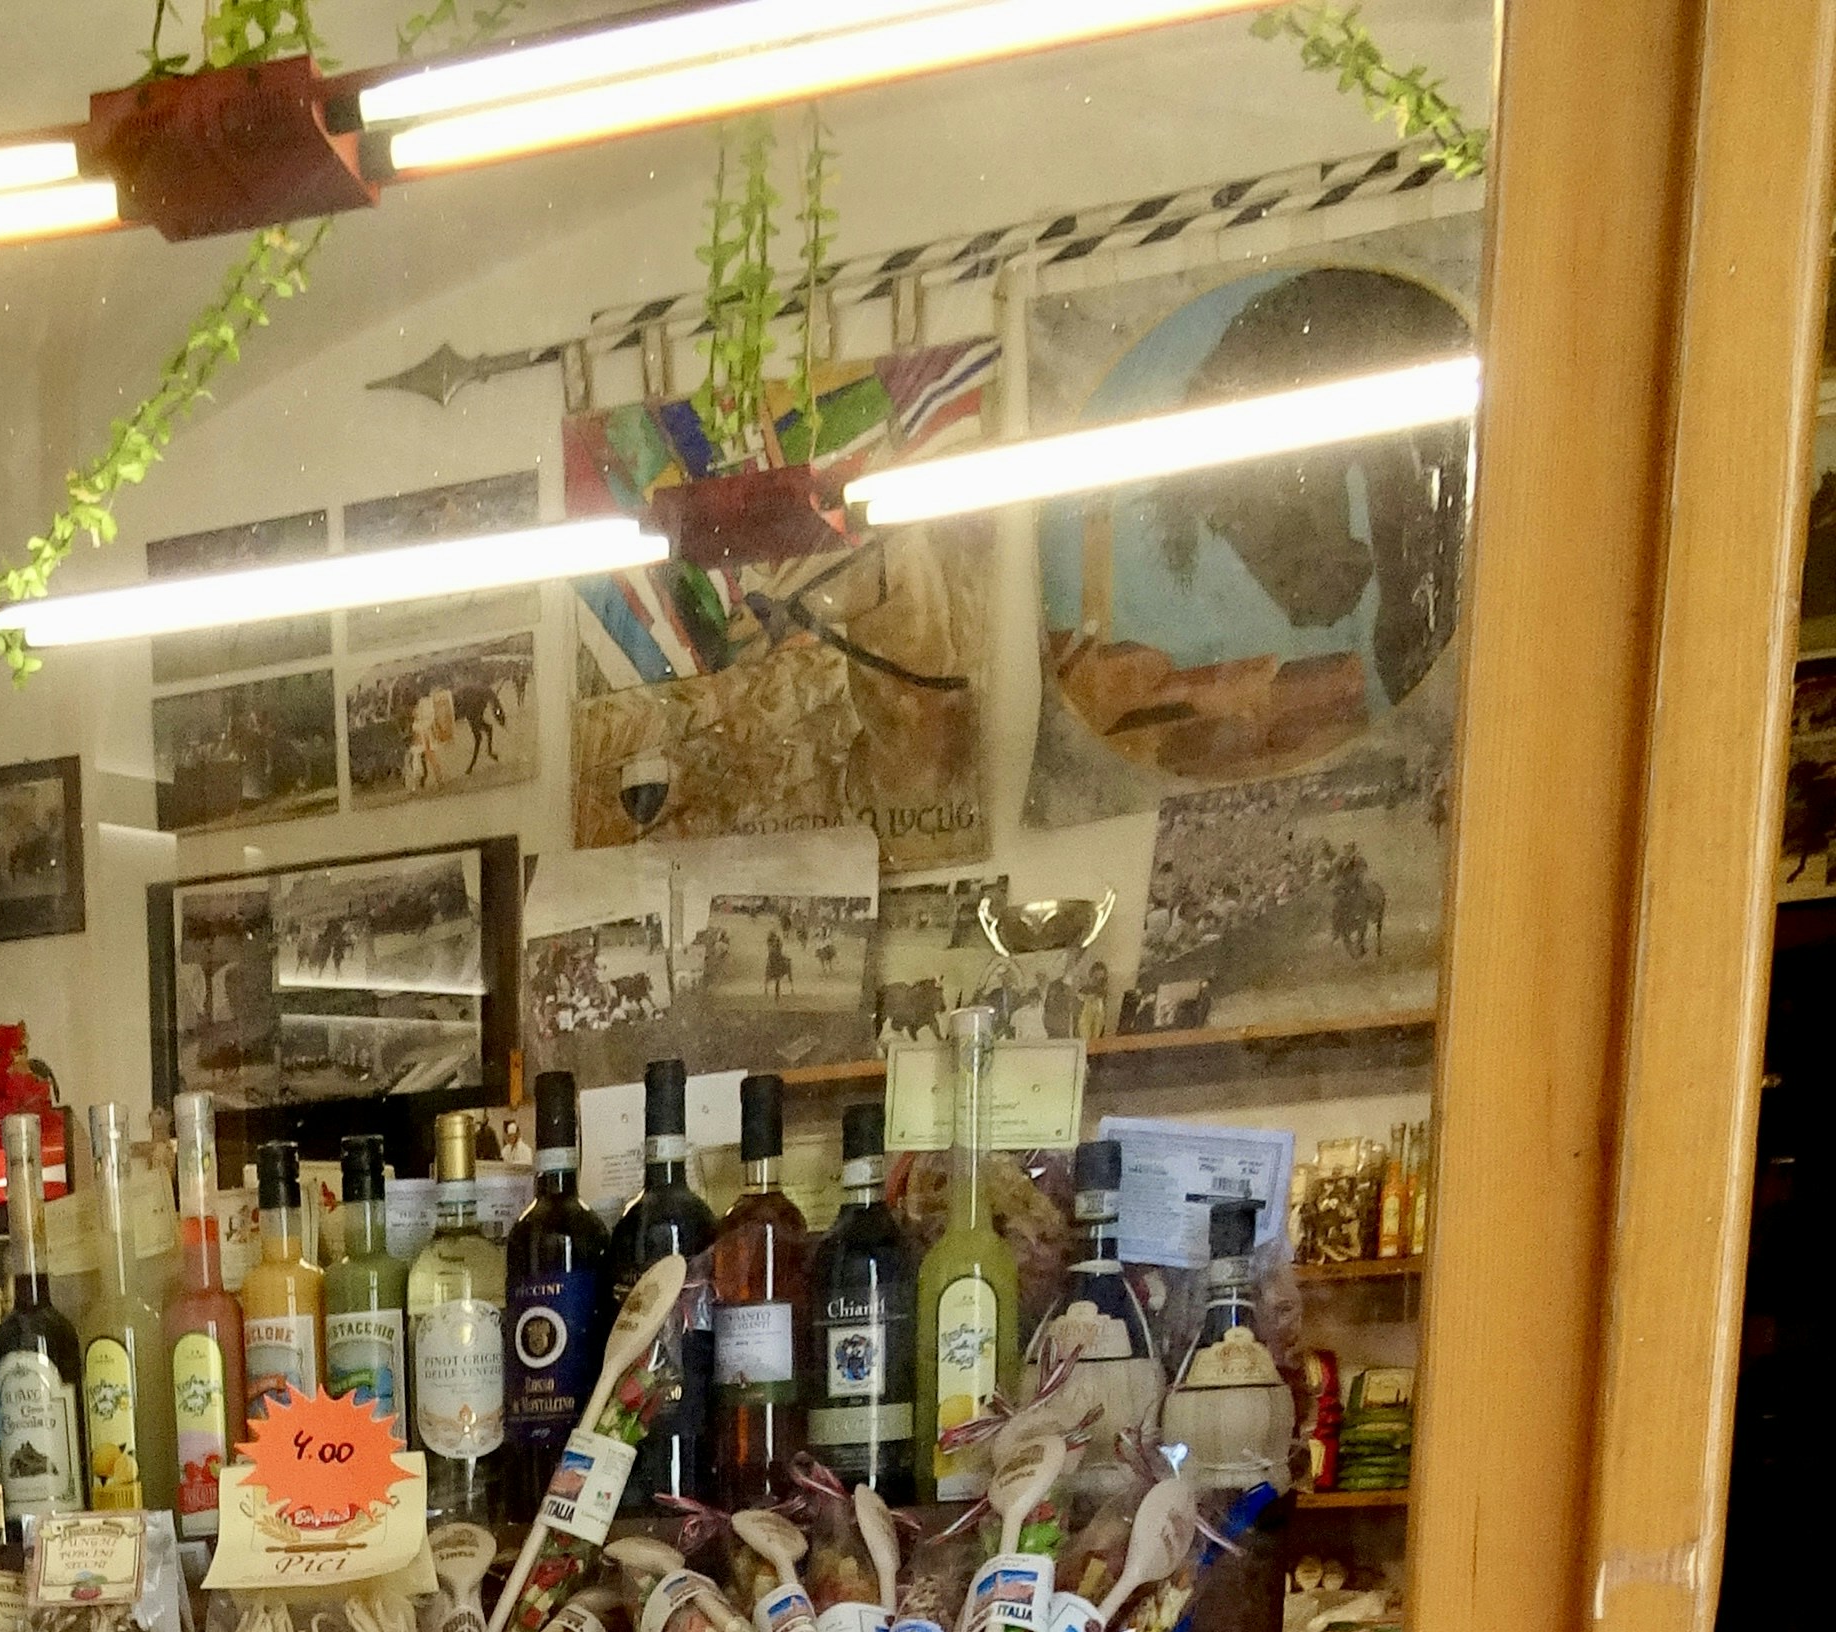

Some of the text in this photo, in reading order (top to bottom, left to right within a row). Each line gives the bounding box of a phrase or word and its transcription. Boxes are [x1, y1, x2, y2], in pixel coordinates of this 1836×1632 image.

[545, 1499, 576, 1525] ITALIA
[276, 1550, 352, 1574] Pici
[996, 1602, 1034, 1623] ITALIA
